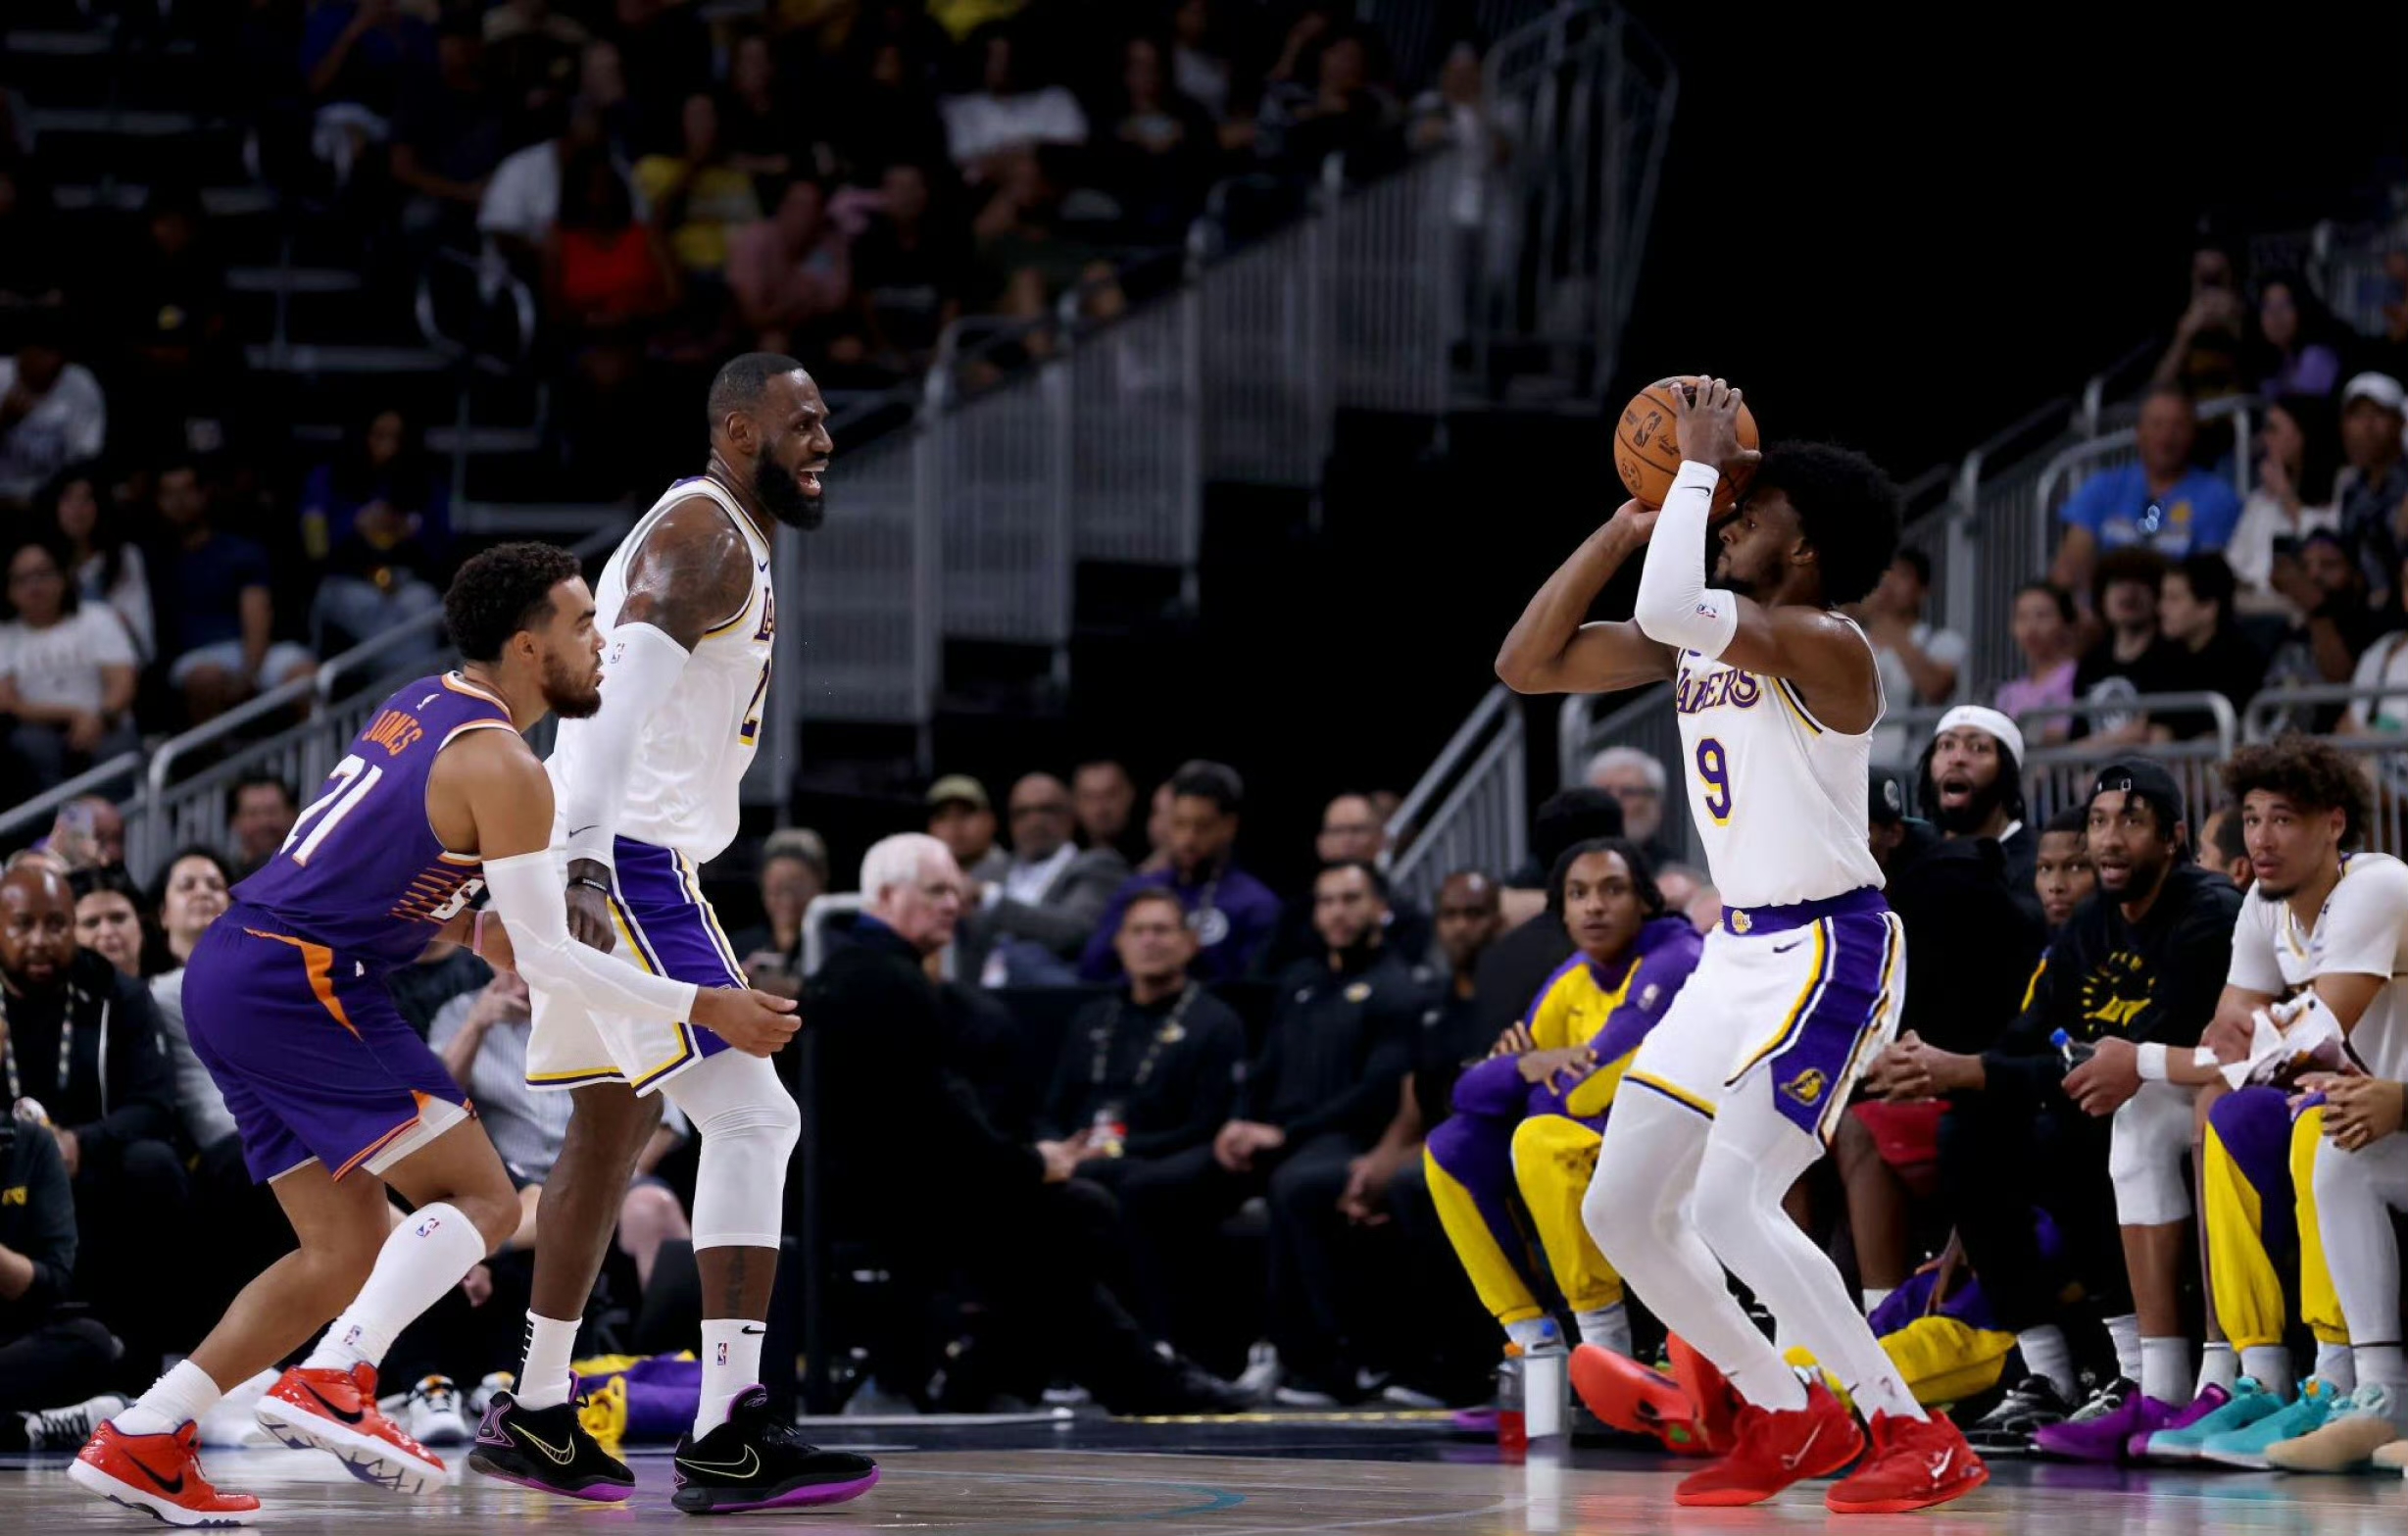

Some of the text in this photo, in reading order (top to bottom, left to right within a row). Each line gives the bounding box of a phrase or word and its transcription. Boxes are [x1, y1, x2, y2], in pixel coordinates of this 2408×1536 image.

[362, 709, 423, 757] JONES
[279, 754, 383, 867] 21
[1695, 737, 1733, 826] 9
